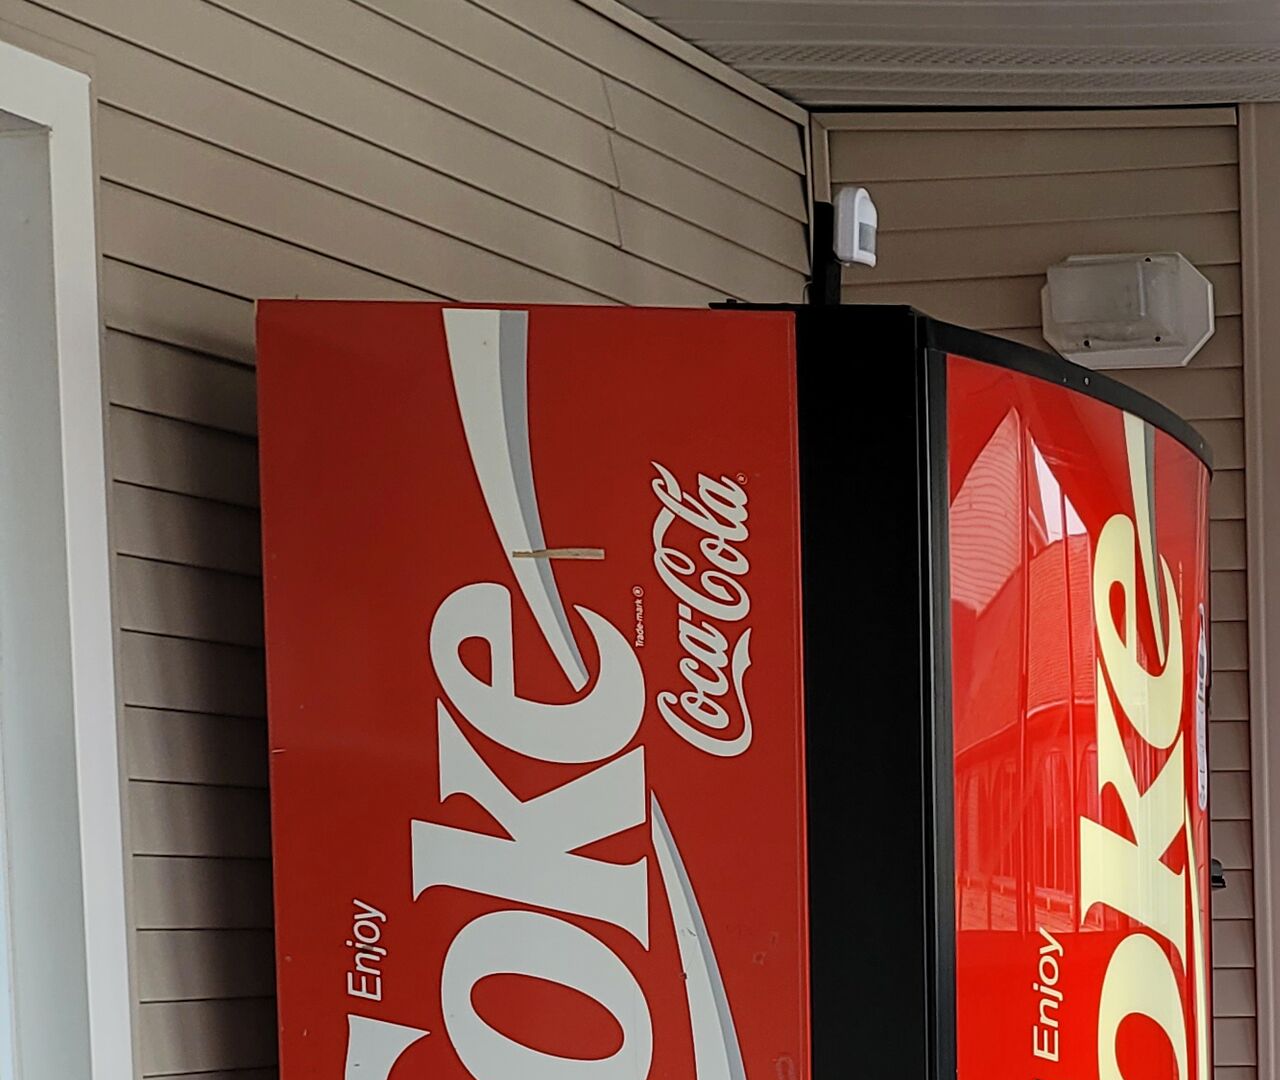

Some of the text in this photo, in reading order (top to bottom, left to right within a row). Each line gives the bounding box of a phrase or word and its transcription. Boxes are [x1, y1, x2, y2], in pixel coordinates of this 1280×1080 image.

[651, 461, 752, 757] Coca-Cola
[347, 899, 387, 1002] Enjoy
[1032, 926, 1062, 1064] Enjoy
